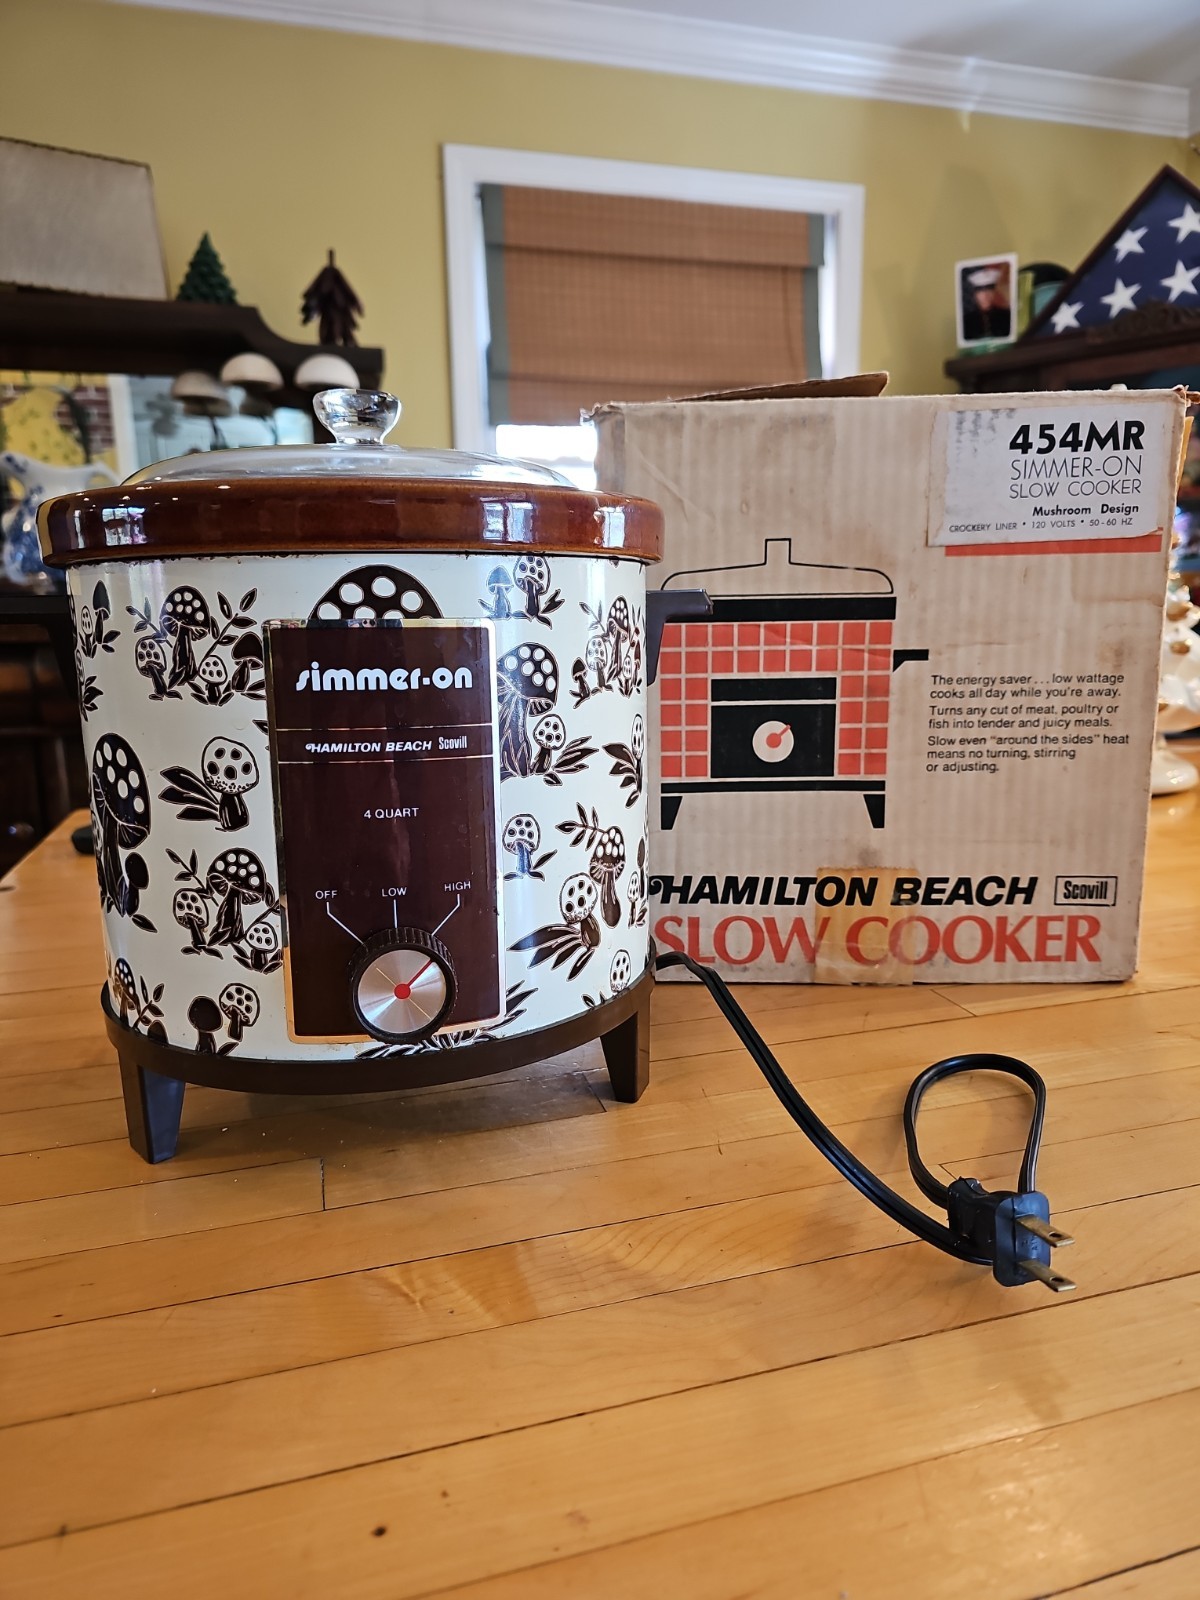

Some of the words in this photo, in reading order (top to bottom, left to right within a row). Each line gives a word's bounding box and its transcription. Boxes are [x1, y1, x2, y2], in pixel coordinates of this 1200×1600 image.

[1009, 420, 1145, 455] 454MR
[1010, 455, 1142, 480] SIMMER-ON
[1010, 482, 1059, 499] SLOW
[1068, 479, 1142, 497] COOKER
[1032, 505, 1091, 517] Mushroom
[1101, 504, 1139, 515] Design
[949, 523, 991, 533] CROCKERY
[995, 522, 1017, 531] LINER
[1032, 521, 1046, 529] 120
[1051, 520, 1075, 528] VOLTS
[296, 661, 472, 691] simmer-on
[931, 675, 953, 685] The
[956, 676, 996, 687] energy
[1052, 674, 1072, 683] low
[1077, 674, 1124, 685] wattage
[930, 689, 965, 699] cooks
[969, 689, 982, 698] all
[985, 688, 1007, 700] day
[1011, 688, 1041, 698] while
[1045, 687, 1082, 699] you're
[1087, 688, 1121, 698] away.
[929, 706, 963, 716] Turns
[966, 707, 987, 717] any
[990, 706, 1008, 715] cut
[1011, 705, 1023, 714] of
[1061, 704, 1103, 716] poultry
[1106, 705, 1119, 713] or
[929, 719, 949, 728] fish
[953, 719, 974, 728] into
[978, 718, 1015, 728] tender
[1018, 718, 1039, 727] and
[1042, 717, 1071, 729] juicy
[1074, 717, 1112, 727] meals.
[305, 742, 381, 753] HAMILTON
[385, 741, 432, 751] BEACH
[439, 736, 467, 750] Scovill
[927, 736, 956, 746] Slow
[959, 737, 987, 745] even
[1040, 735, 1059, 744] the
[1103, 734, 1129, 744] heat
[927, 750, 965, 758] means
[969, 750, 983, 758] no
[1034, 748, 1076, 759] stirring
[926, 764, 938, 772] or
[943, 762, 999, 774] adjusting.
[364, 809, 372, 819] 4
[375, 807, 419, 818] QUART
[381, 887, 407, 897] LOW
[444, 881, 471, 891] HIGH
[649, 875, 878, 905] HAMILTON
[891, 875, 1038, 906] BEACH
[1062, 880, 1108, 900] Scovill
[315, 890, 338, 899] OFF
[654, 915, 830, 966] SLOW
[845, 914, 1102, 966] COOKER
